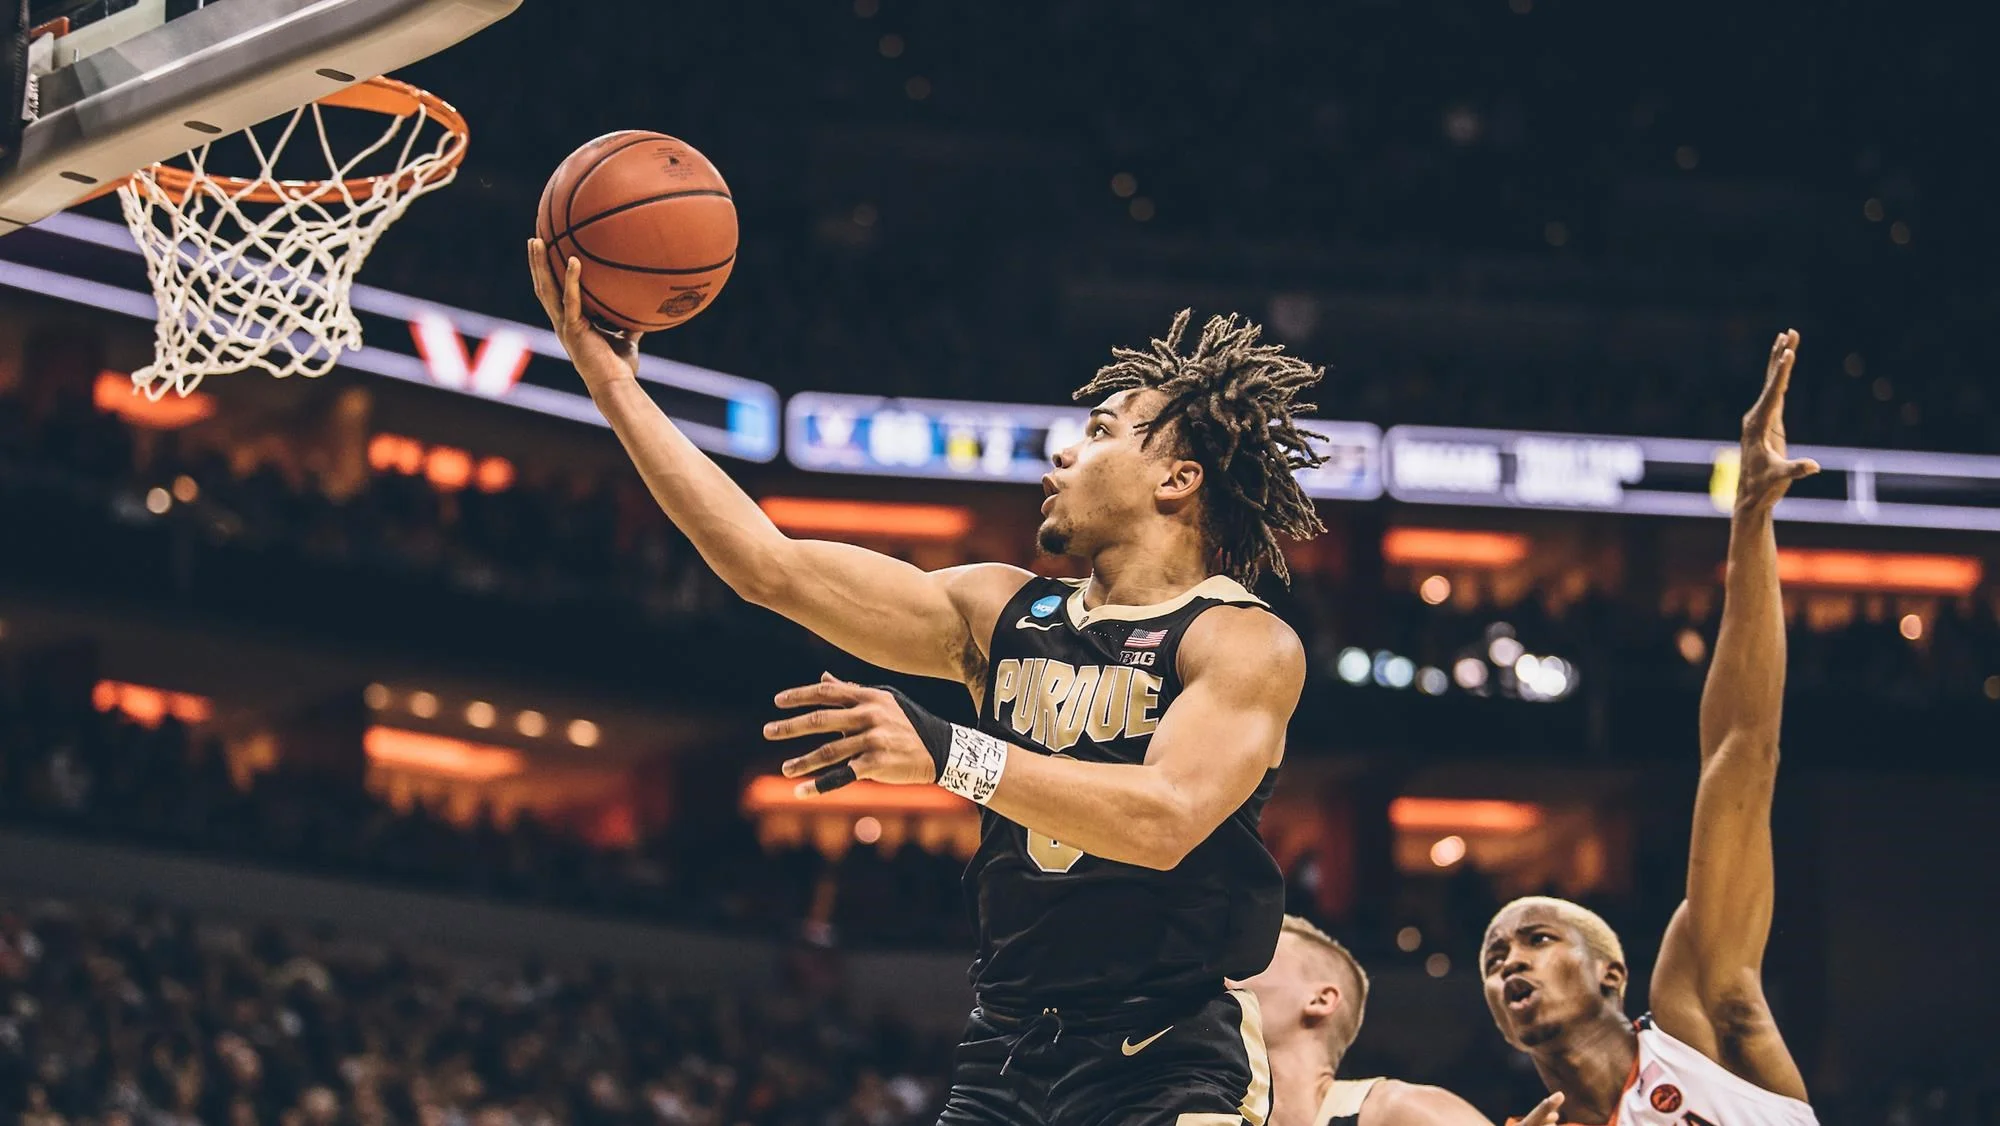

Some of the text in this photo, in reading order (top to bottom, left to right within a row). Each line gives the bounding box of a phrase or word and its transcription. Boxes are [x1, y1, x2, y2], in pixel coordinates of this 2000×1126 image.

[994, 657, 1163, 753] PURDUE
[950, 728, 969, 769] OUT
[981, 739, 1005, 782] HELP
[946, 766, 971, 781] LOVE
